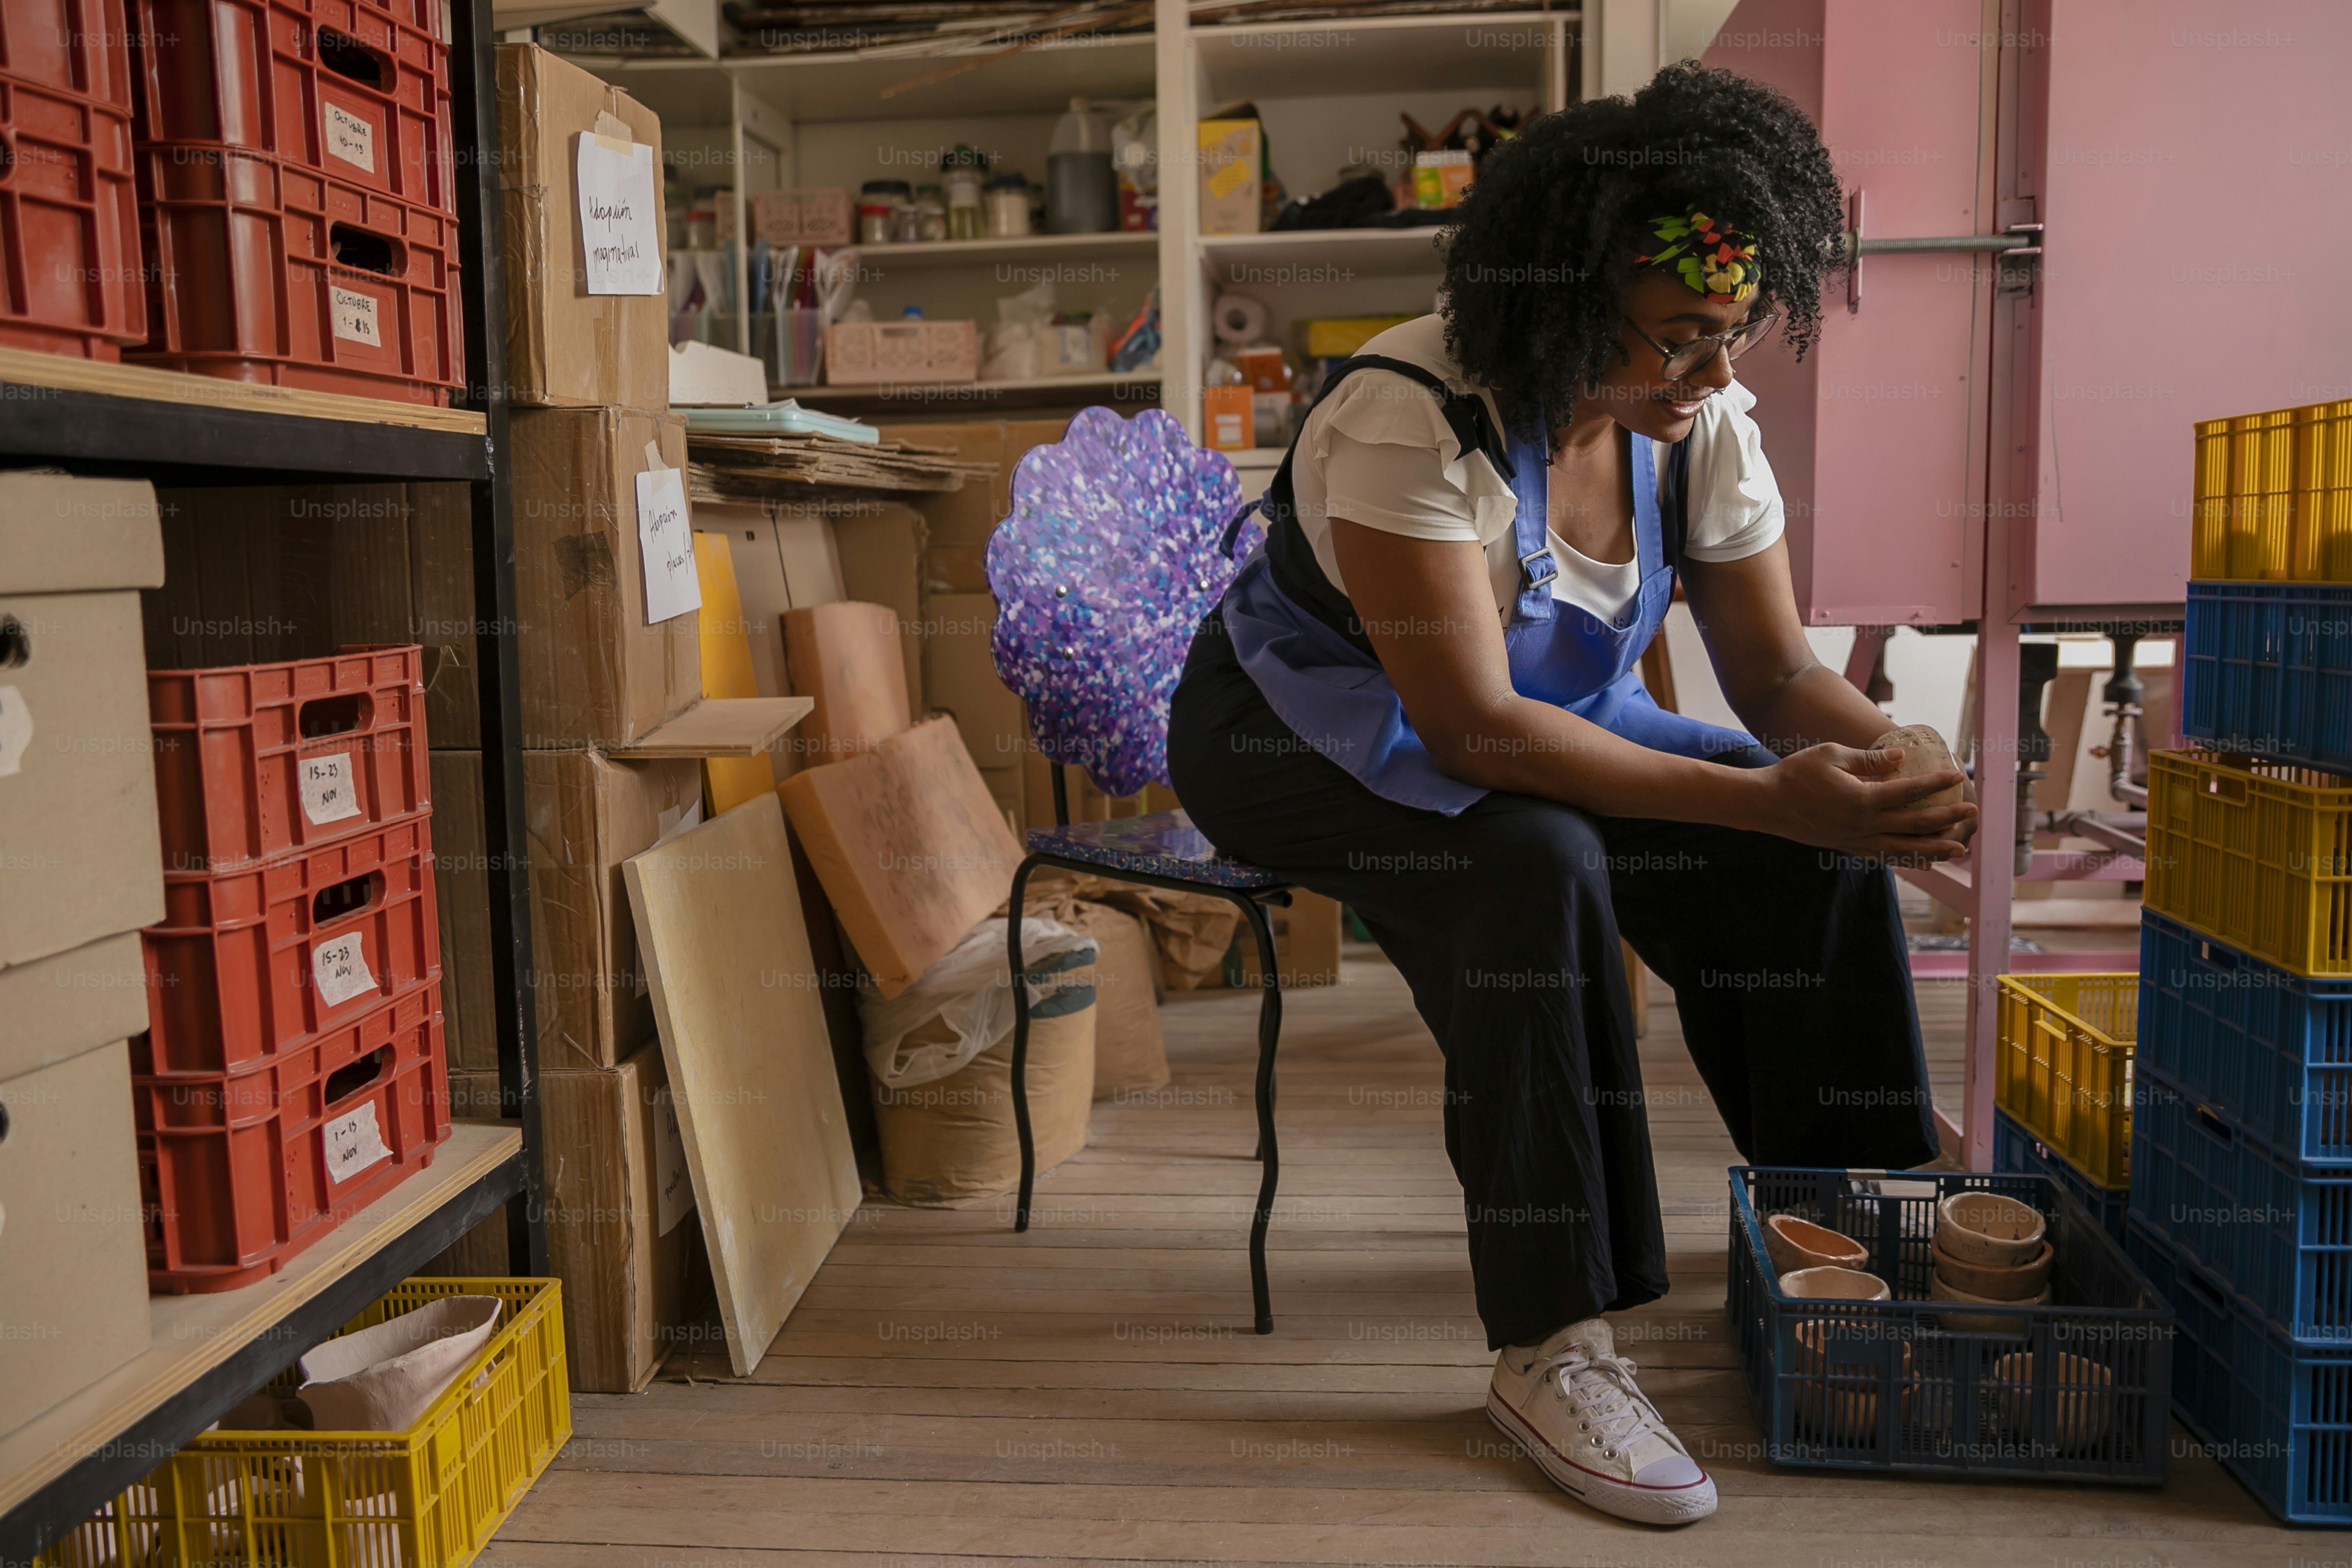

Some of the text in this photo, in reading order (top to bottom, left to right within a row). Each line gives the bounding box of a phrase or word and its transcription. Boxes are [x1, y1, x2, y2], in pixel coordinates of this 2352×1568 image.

[335, 110, 367, 136] OCTUBRE
[336, 291, 371, 312] OCTUBRE
[310, 763, 338, 780] 15-23
[322, 787, 336, 806] NOV
[322, 946, 350, 966] 15-23
[335, 965, 351, 979] NOV
[335, 1120, 357, 1142] 1-15
[343, 1142, 357, 1162] NOV
